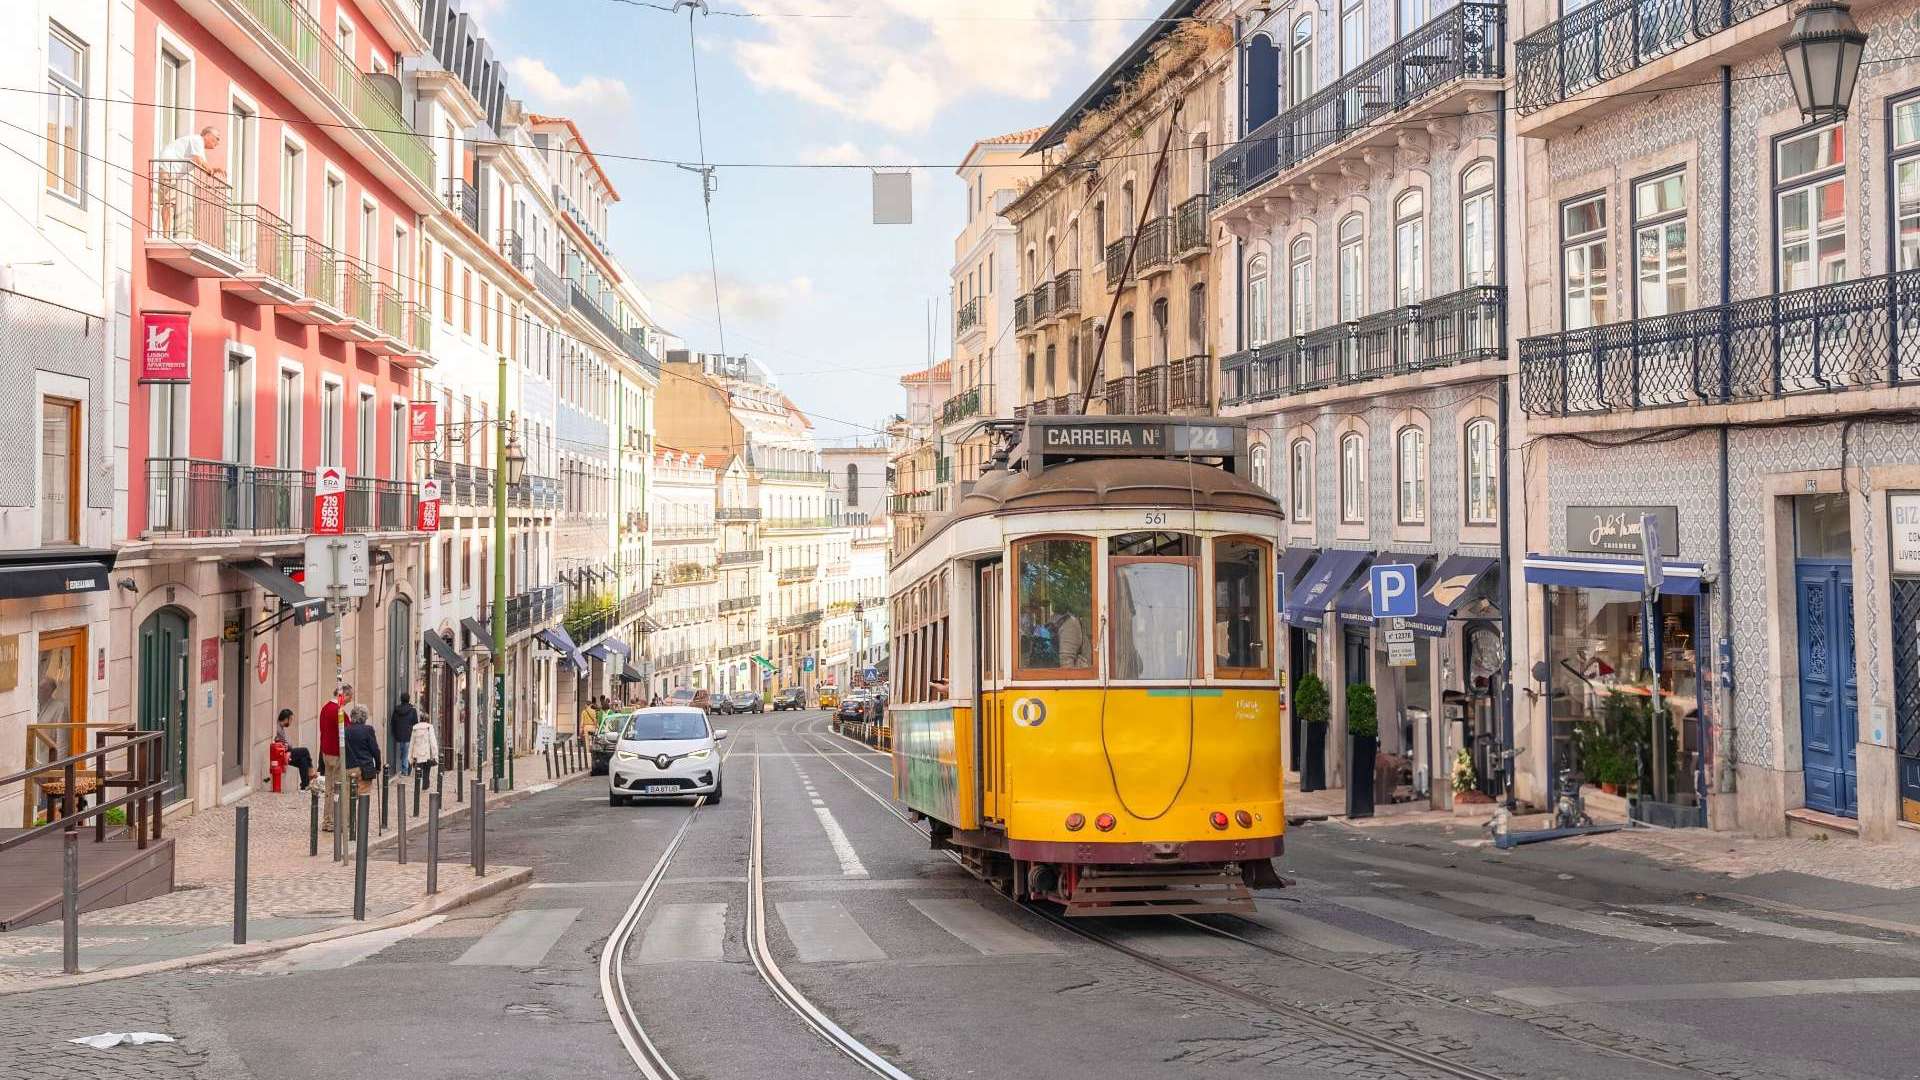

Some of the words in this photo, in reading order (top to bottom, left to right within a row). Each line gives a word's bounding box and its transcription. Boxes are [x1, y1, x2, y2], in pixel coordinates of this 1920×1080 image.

[1048, 429, 1132, 445] CARREIRA
[1190, 426, 1218, 449] 24
[323, 495, 339, 507] 219
[321, 506, 339, 517] 663
[1145, 512, 1166, 525] 561
[1895, 506, 1919, 525] BIZ
[321, 516, 339, 528] 780
[1589, 515, 1616, 546] John
[1381, 571, 1406, 612] P
